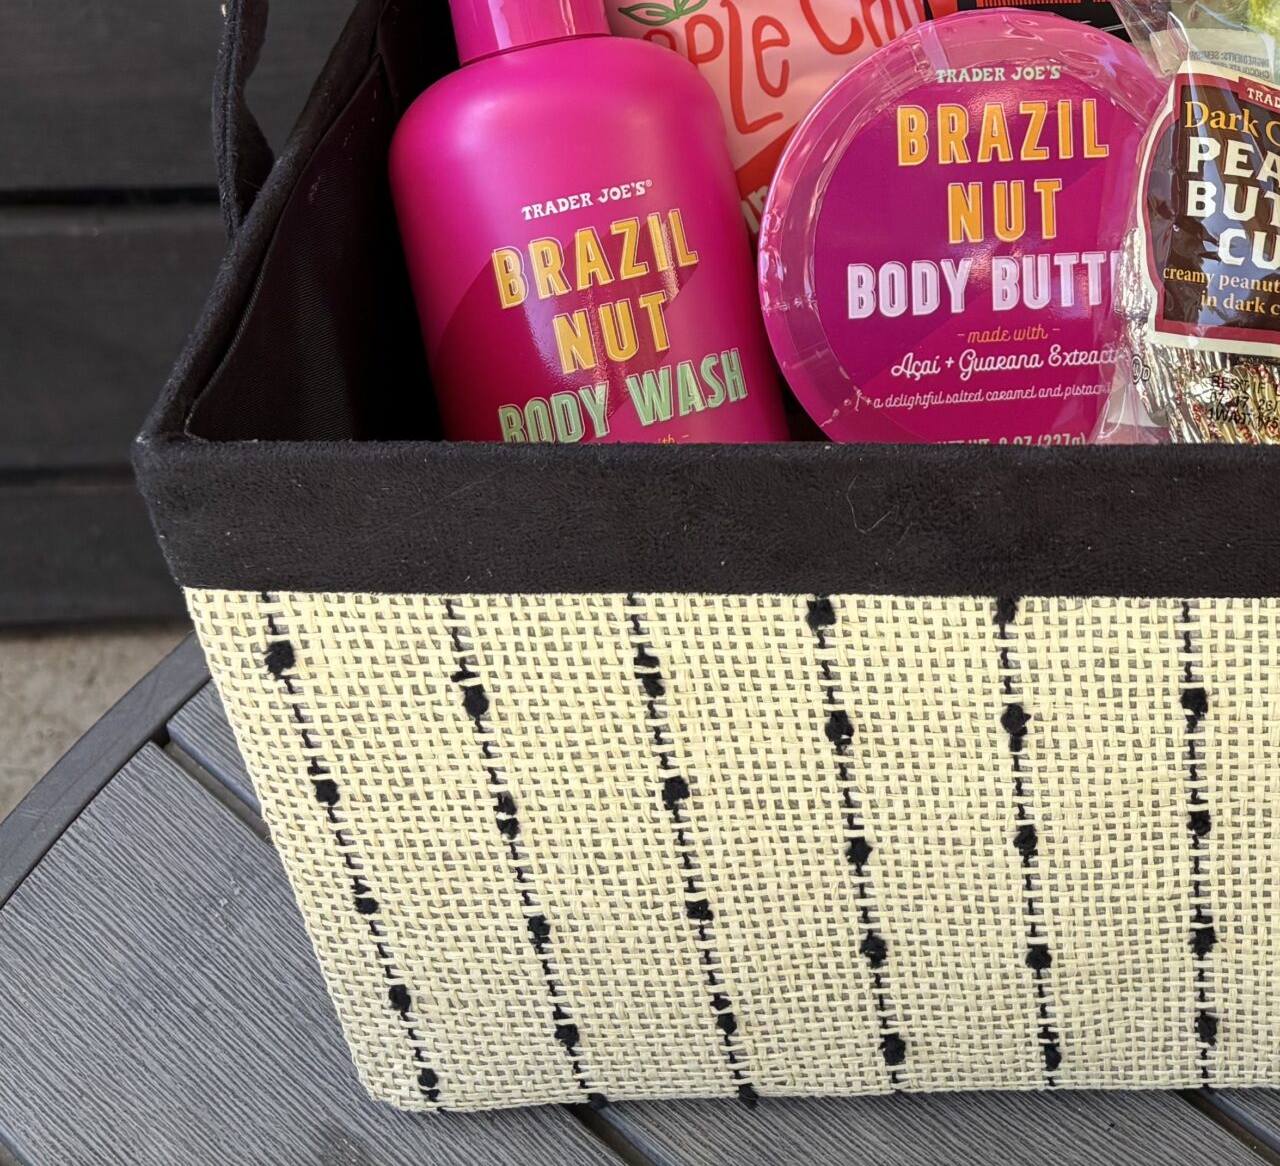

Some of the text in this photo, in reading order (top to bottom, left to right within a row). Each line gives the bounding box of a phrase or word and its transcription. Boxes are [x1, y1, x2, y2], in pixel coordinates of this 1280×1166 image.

[935, 66, 1006, 84] TRADER
[897, 98, 1110, 166] BRAZIL
[1184, 100, 1259, 135] Dark
[521, 192, 594, 220] TRADER
[947, 178, 1062, 244] NUT
[491, 209, 699, 309] BRAZIL
[847, 257, 973, 320] BODY
[1162, 266, 1214, 286] creamy
[1218, 273, 1280, 297] peanut
[1200, 289, 1218, 308] in
[1222, 293, 1266, 317] dark
[552, 290, 670, 374] NUT
[967, 323, 1049, 345] made with
[1047, 344, 1119, 366] Extract
[499, 348, 748, 443] BODY WASH
[885, 391, 944, 411] delightful
[944, 388, 984, 405] salted
[985, 386, 1036, 402] caramel
[1038, 383, 1064, 399] and
